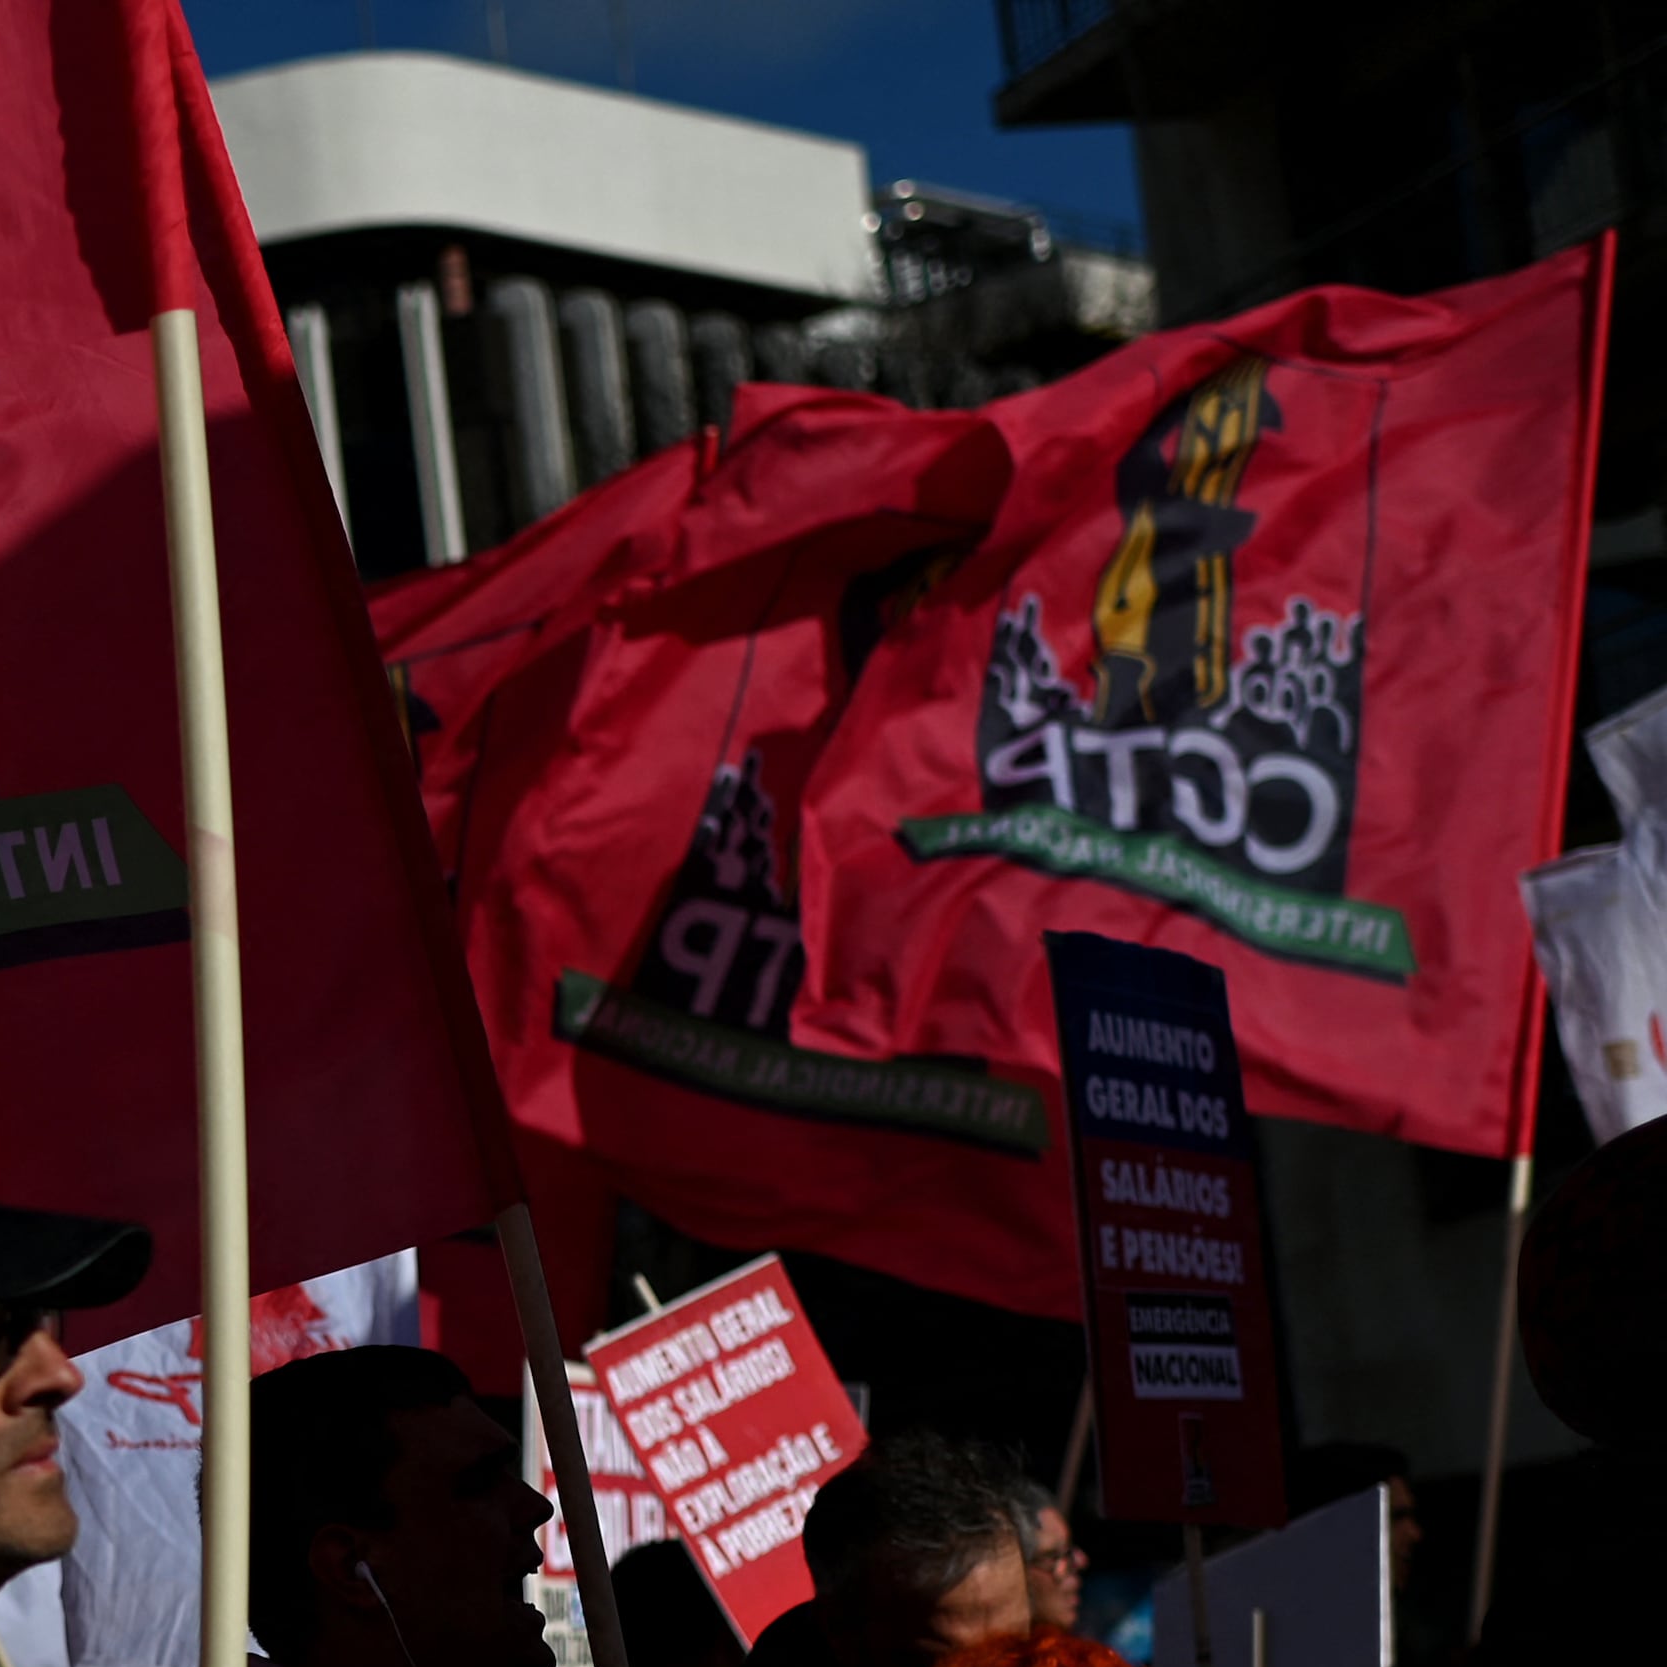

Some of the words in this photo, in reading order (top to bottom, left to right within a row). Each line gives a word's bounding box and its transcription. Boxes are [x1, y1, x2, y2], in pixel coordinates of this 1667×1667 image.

[1086, 1008, 1217, 1075] AUMENTO
[1084, 1073, 1175, 1128] GERAL
[1177, 1091, 1230, 1140] DOS
[1098, 1152, 1231, 1219] SALÁRIOS
[1098, 1224, 1119, 1270] E
[1122, 1225, 1245, 1285] PENSÕES!
[605, 1321, 719, 1406] AUMENTO
[709, 1284, 796, 1353] GERAL
[1129, 1300, 1232, 1337] EMERGÊNCIA
[625, 1402, 685, 1452] DOS
[674, 1336, 797, 1427] SALÁRIOS!
[1135, 1354, 1238, 1386] NACIONAL
[648, 1440, 704, 1494] NÃO
[674, 1432, 815, 1537] EXPLORAÇÃO
[809, 1421, 843, 1463] E
